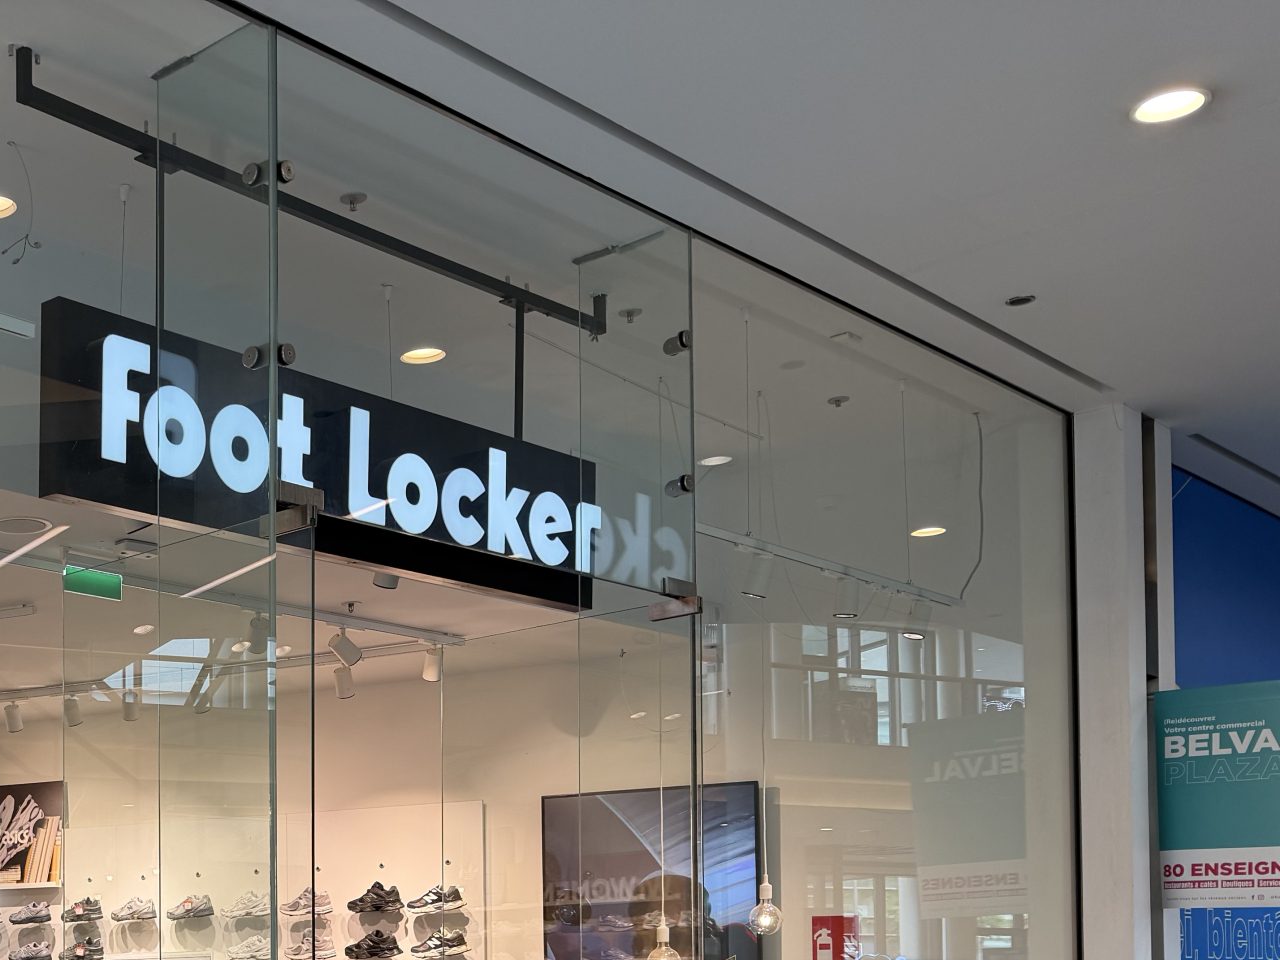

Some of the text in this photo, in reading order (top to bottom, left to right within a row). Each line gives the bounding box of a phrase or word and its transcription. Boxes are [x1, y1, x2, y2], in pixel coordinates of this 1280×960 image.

[100, 334, 602, 573] Foot Locker
[1188, 724, 1214, 732] centre
[1217, 720, 1265, 730] commercial
[1165, 728, 1280, 758] BELVA
[1165, 755, 1280, 785] PLAZA
[1163, 863, 1185, 877] 80
